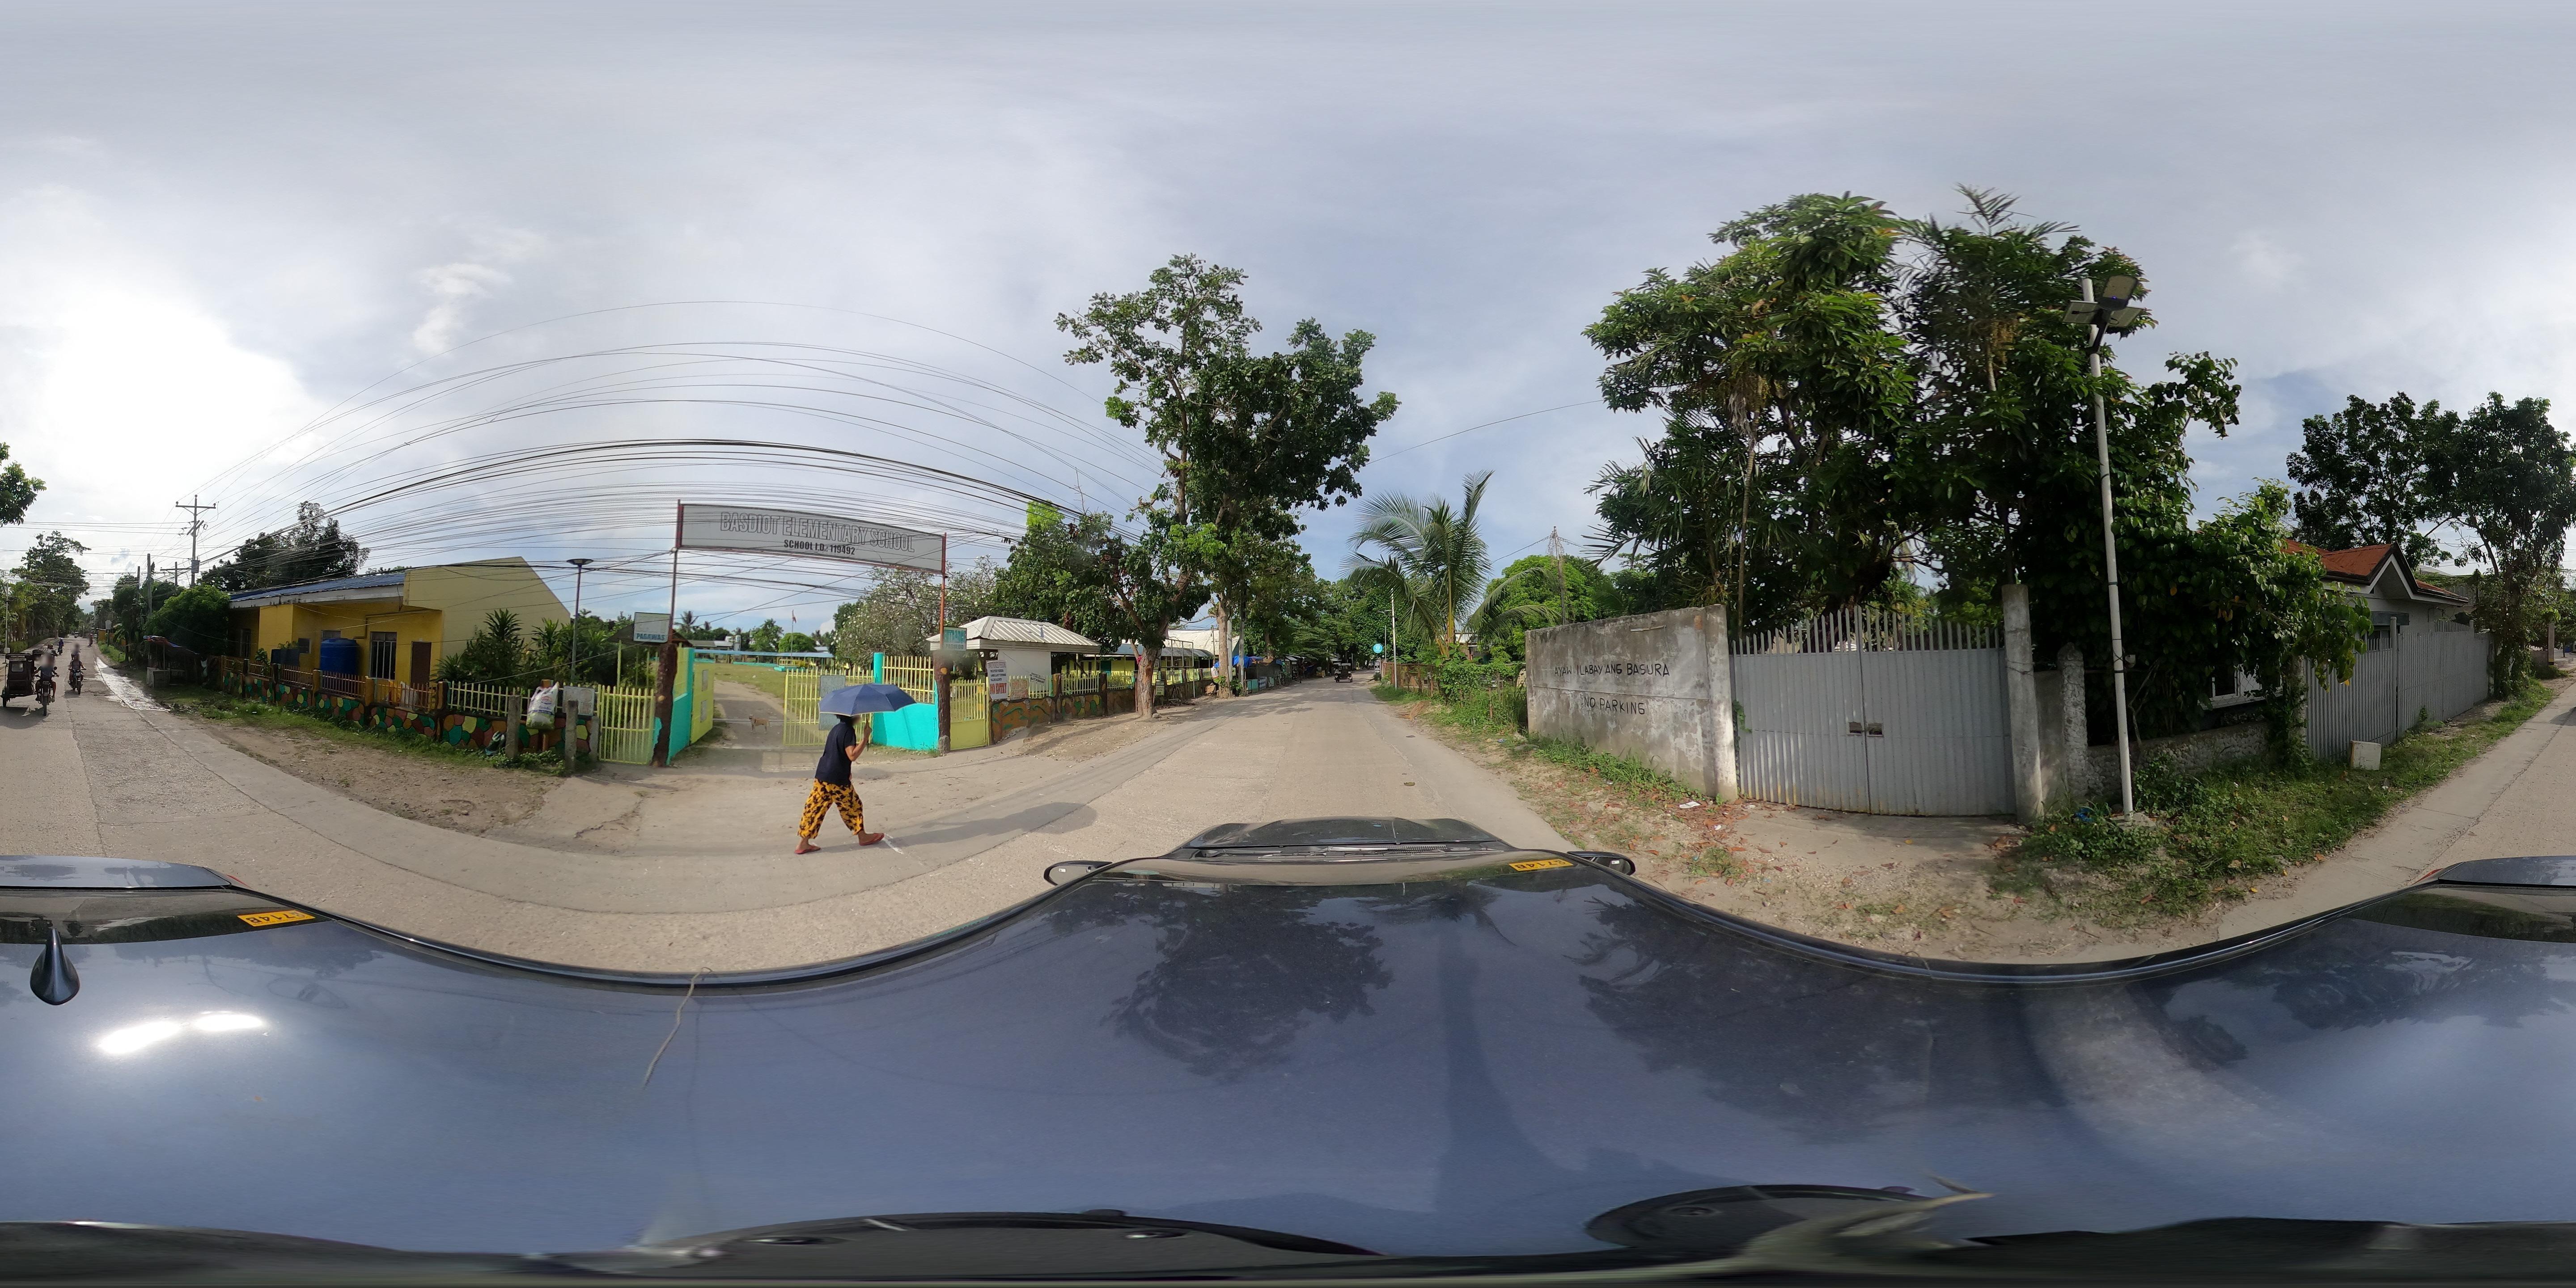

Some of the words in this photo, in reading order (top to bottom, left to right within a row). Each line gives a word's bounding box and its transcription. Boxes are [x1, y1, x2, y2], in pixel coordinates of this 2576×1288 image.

[720, 512, 780, 534] BASDIOT
[783, 516, 869, 545] ELEMENTARY
[870, 529, 915, 552] SCHOOL
[784, 539, 813, 550] SCHOOL
[830, 545, 855, 555] 119492
[1555, 666, 1572, 677] AYAW
[1577, 665, 1603, 676] ILABAY
[1605, 663, 1623, 674] ANG
[1627, 663, 1669, 677] BASURA
[1584, 697, 1596, 708] NO
[1600, 698, 1645, 715] PARKING
